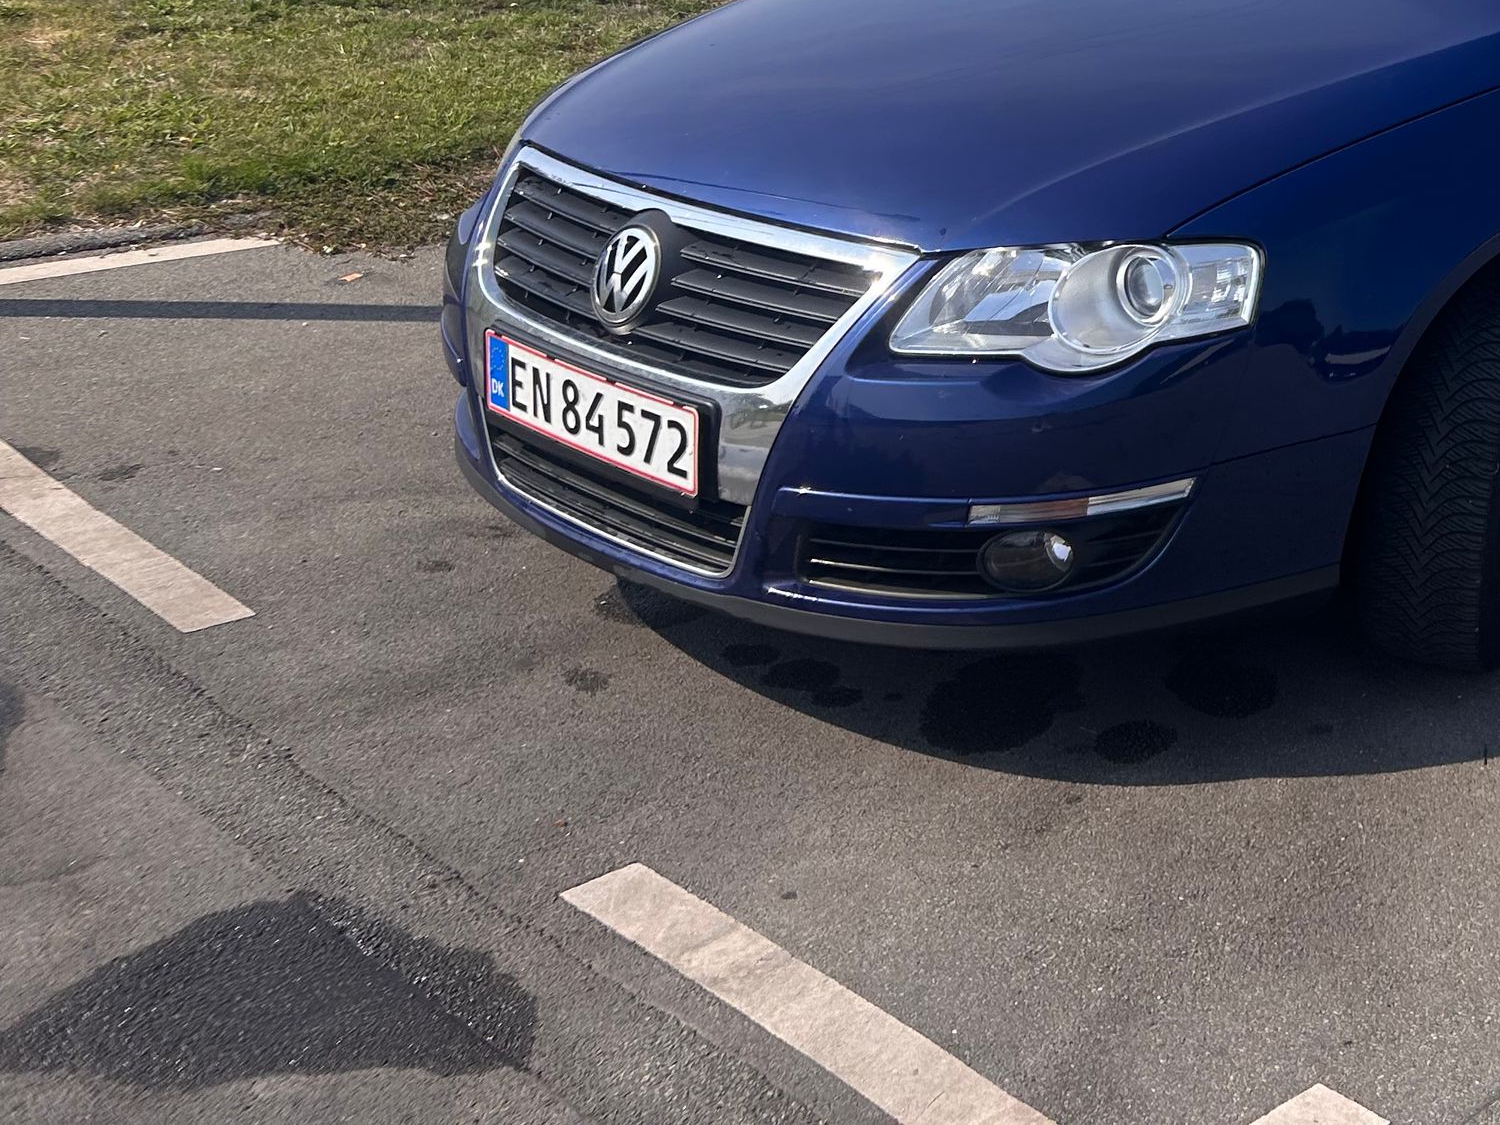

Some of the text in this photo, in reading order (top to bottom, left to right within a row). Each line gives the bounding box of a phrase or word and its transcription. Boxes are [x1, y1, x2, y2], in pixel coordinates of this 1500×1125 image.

[594, 227, 658, 325] VW
[491, 378, 505, 397] DK
[510, 356, 552, 425] EN
